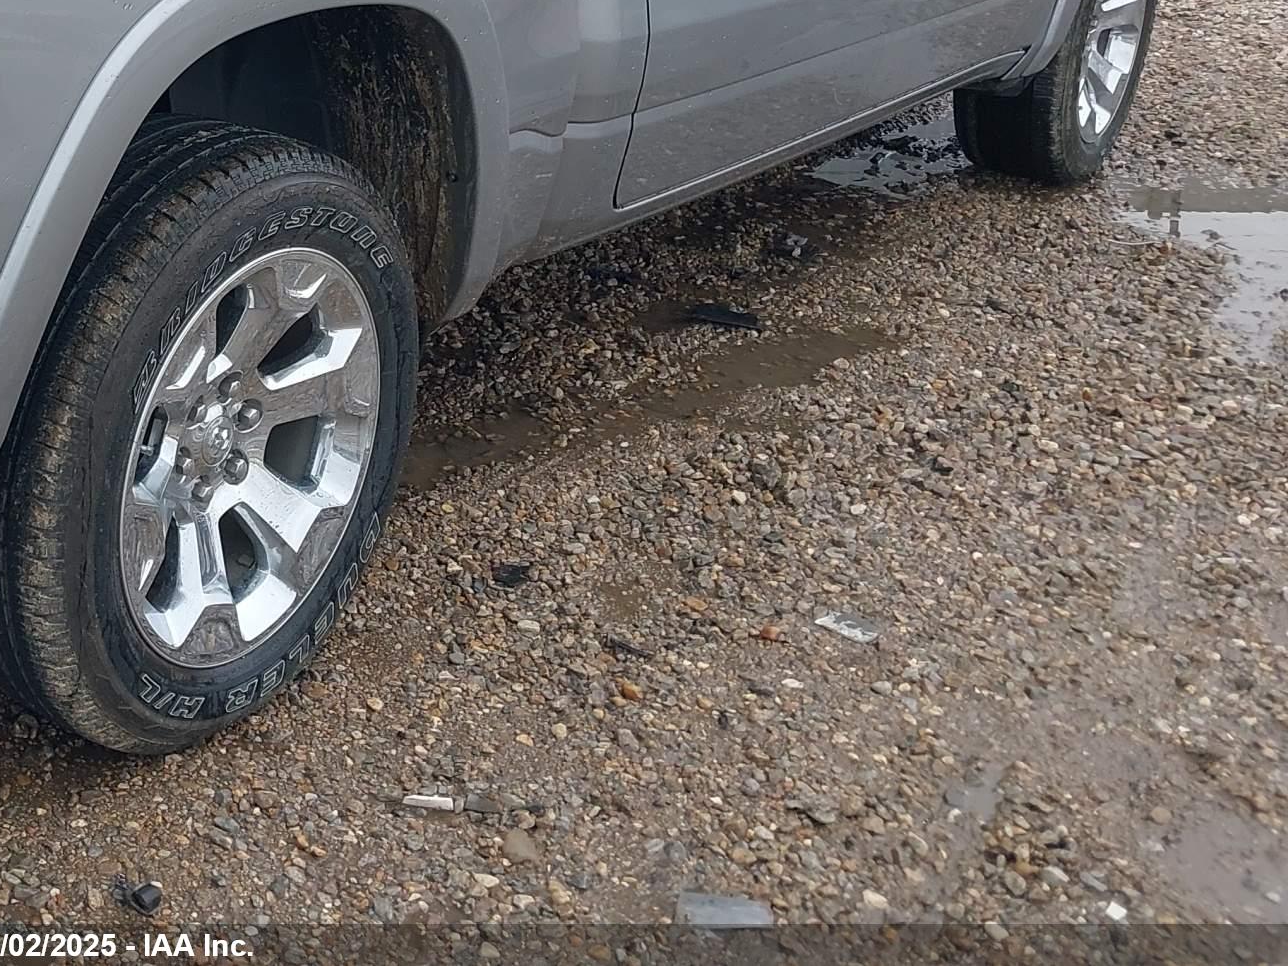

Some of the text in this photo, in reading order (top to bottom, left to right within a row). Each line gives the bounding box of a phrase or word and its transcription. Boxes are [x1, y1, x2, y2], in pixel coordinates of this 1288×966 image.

[132, 206, 394, 415] BRIDGESTONE
[139, 511, 382, 719] DUELER H/L
